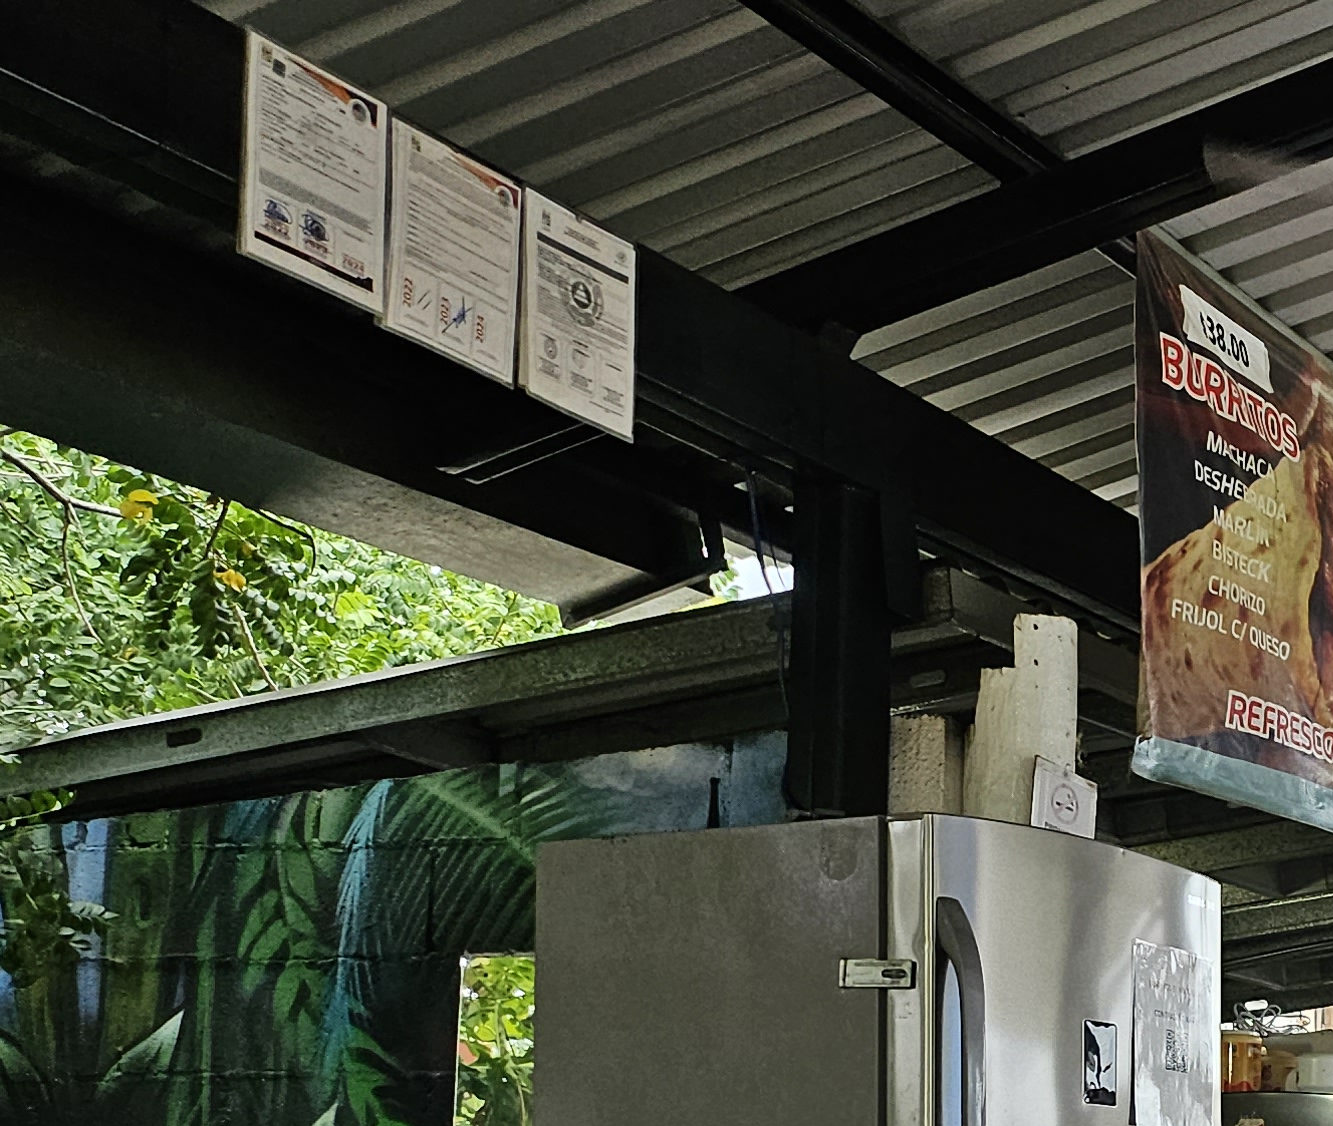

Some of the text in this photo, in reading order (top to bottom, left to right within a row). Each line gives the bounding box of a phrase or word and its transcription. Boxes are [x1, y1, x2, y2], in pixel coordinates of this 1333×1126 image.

[1160, 331, 1300, 460] BURRITOS
[1206, 430, 1275, 484] MACHACA
[1194, 460, 1287, 523] DESHEBRADA
[1212, 540, 1272, 583] BISTECK
[1208, 575, 1266, 616] CHORIZO
[1171, 598, 1290, 660] FRIJOL C/ QUESO
